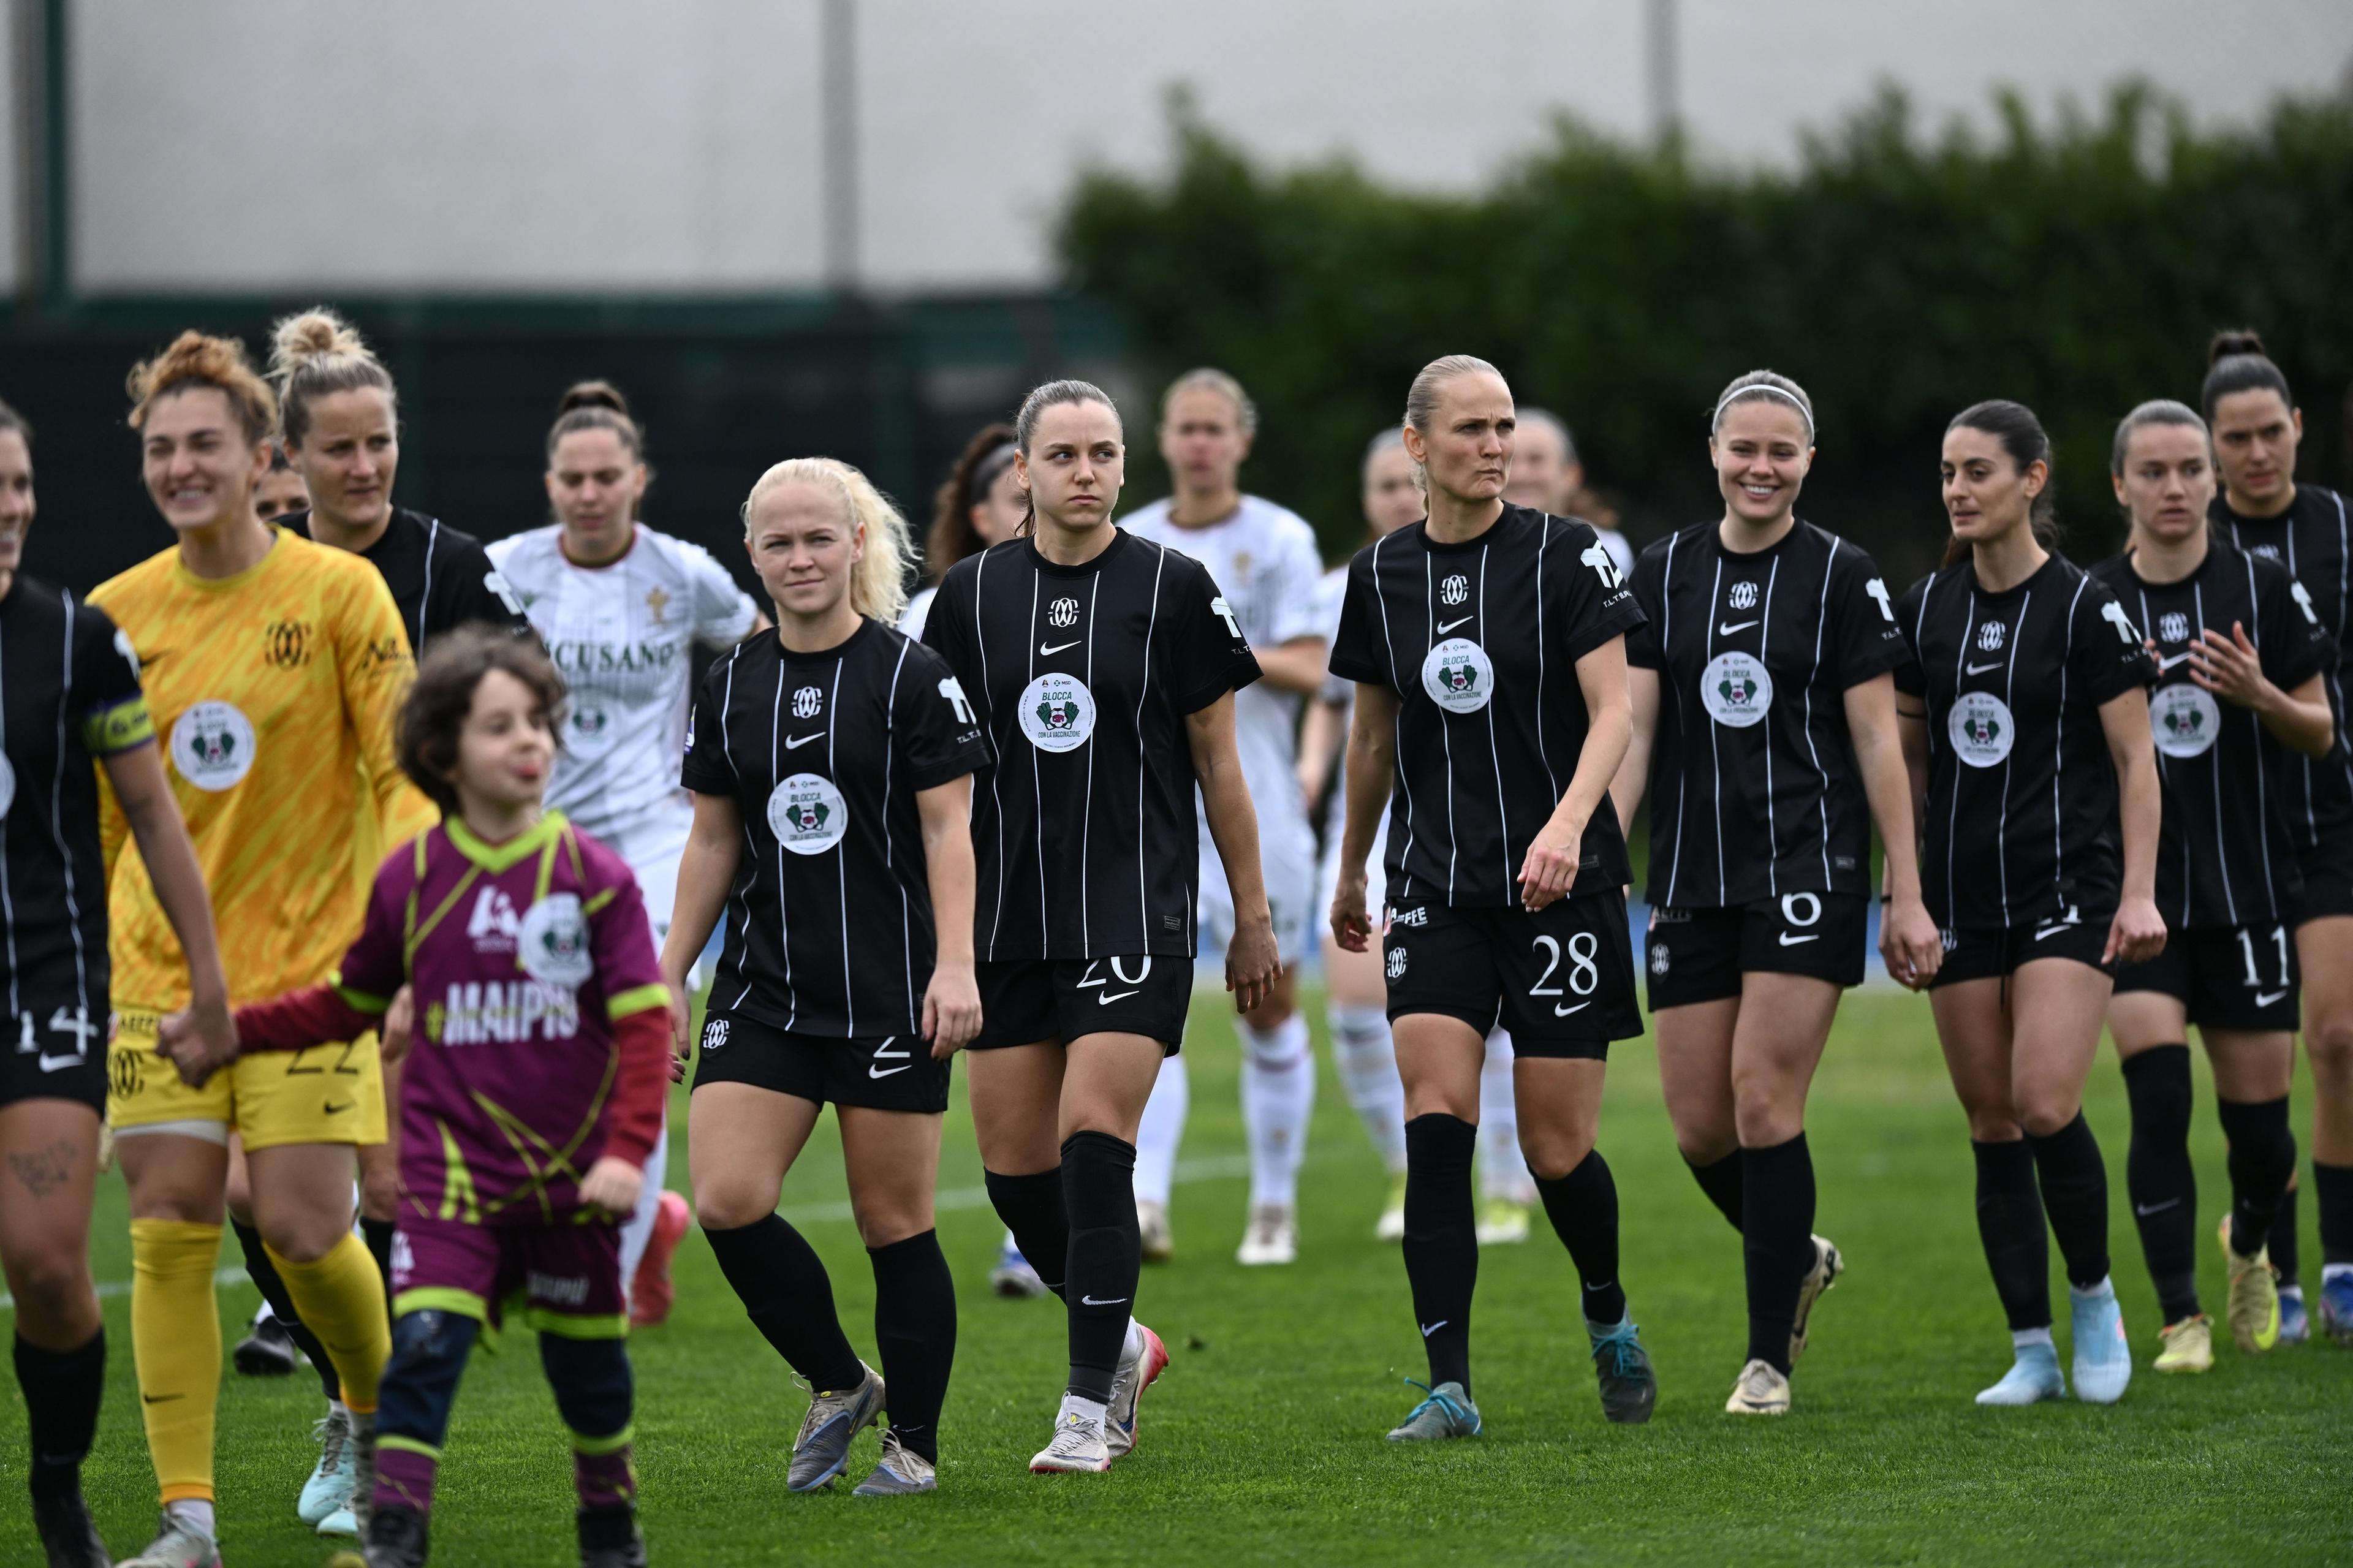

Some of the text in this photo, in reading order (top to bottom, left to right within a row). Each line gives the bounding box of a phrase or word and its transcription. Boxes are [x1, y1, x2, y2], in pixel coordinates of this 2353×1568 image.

[1442, 656, 1469, 665] BLOCCA
[1042, 692, 1072, 700] BLOCCA
[1457, 691, 1482, 700] VACCINAZIONE
[790, 793, 821, 803] BLOCCA
[2236, 925, 2290, 987] 11
[1529, 932, 1598, 996] 28
[14, 1006, 99, 1056] 14
